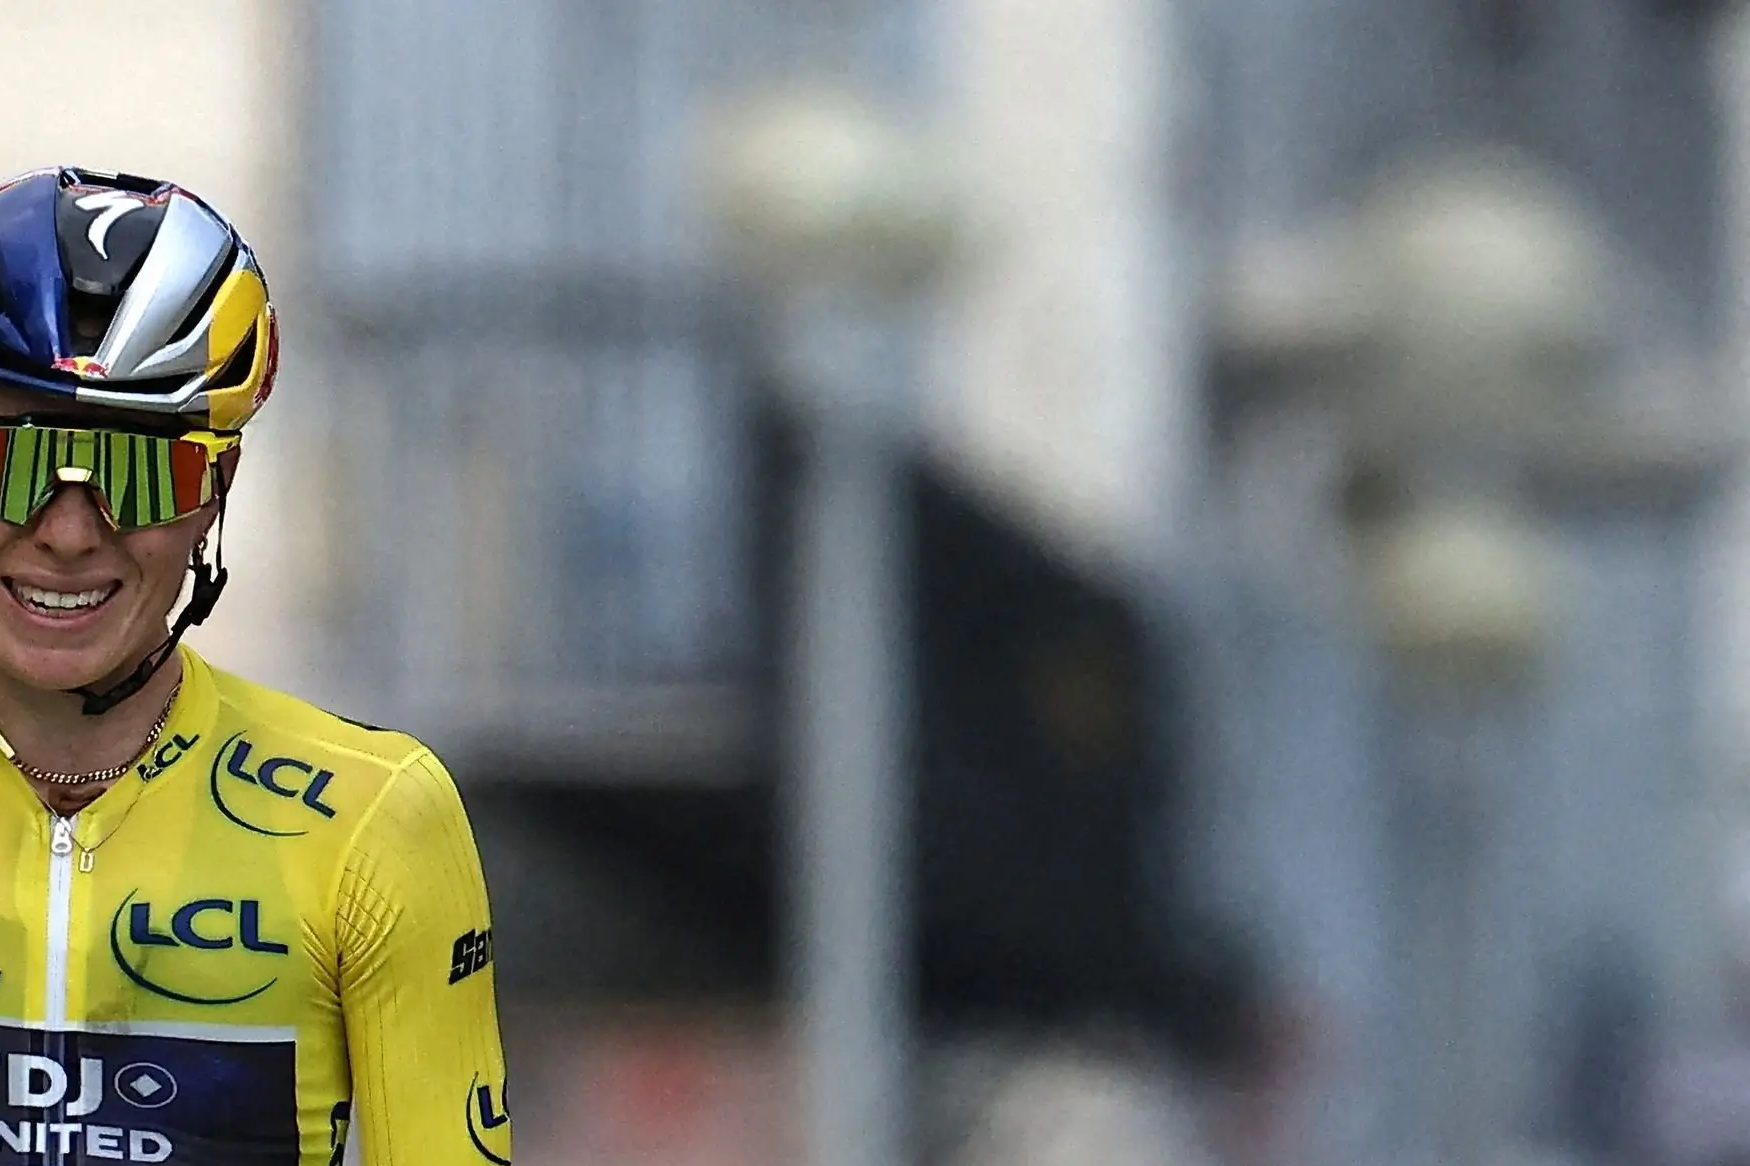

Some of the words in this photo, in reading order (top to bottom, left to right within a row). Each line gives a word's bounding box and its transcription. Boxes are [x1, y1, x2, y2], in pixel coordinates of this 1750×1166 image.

[227, 740, 337, 819] LCL
[130, 899, 290, 956] LCL
[448, 927, 493, 986] Sa
